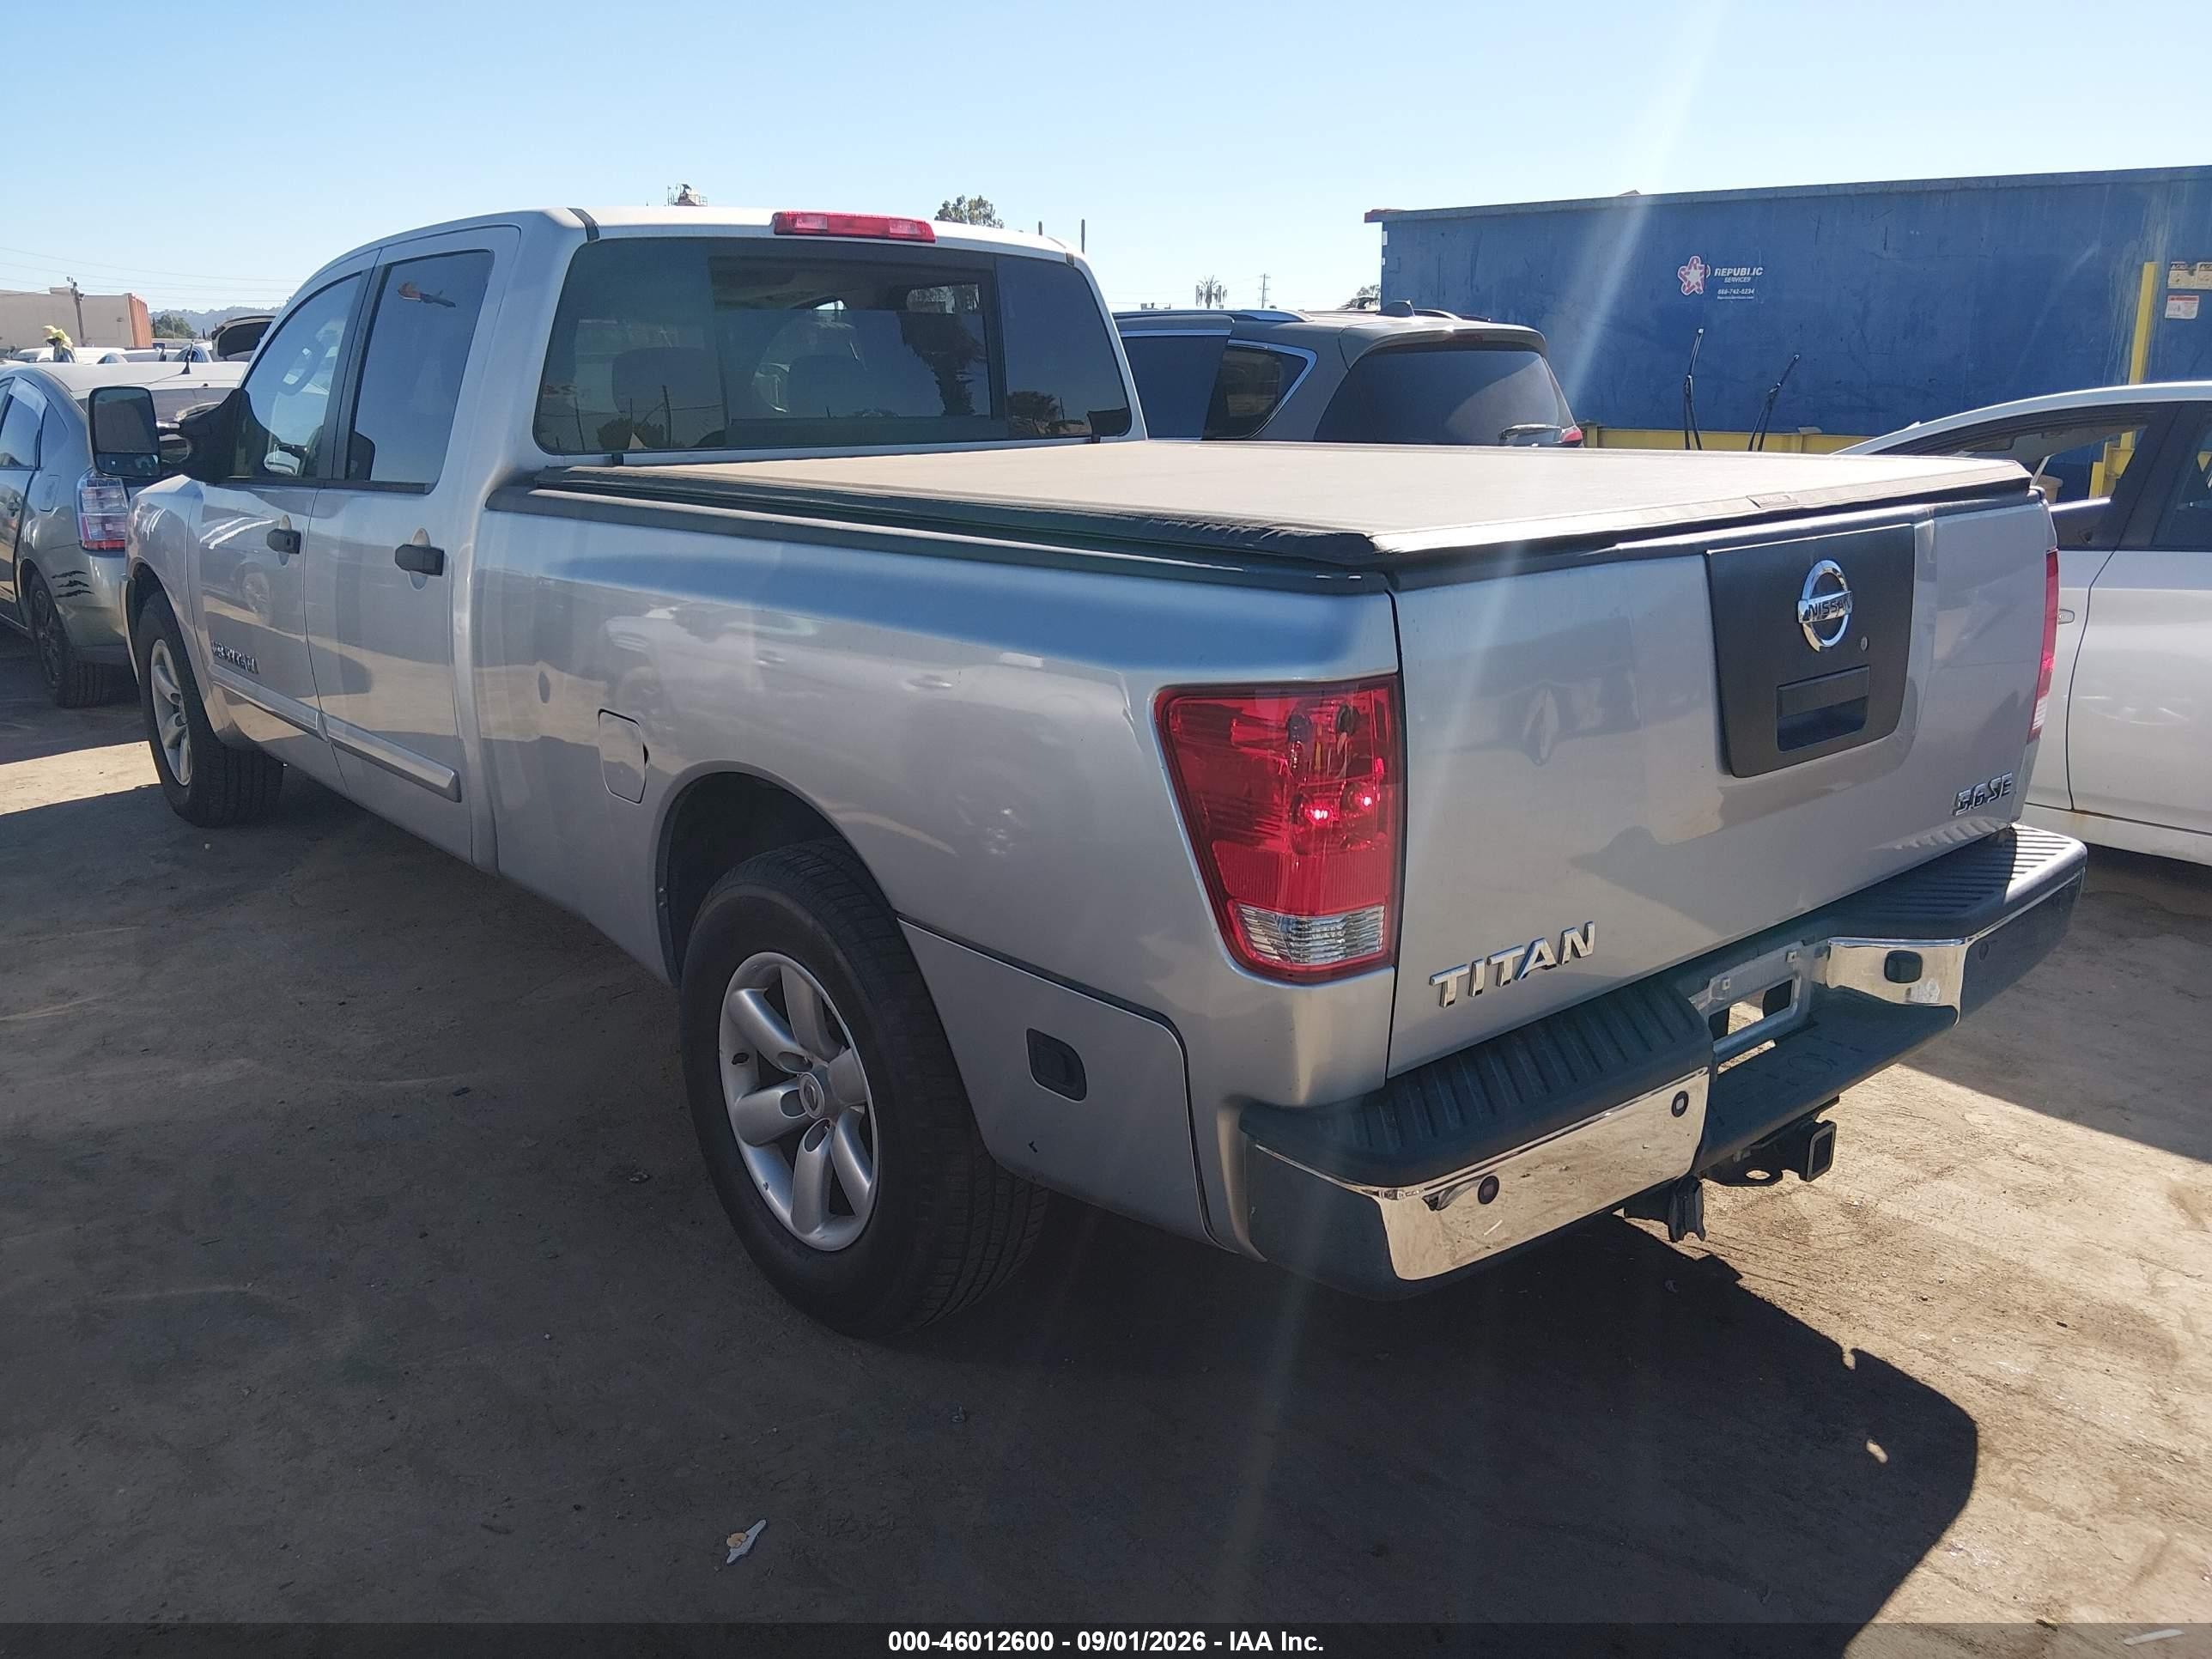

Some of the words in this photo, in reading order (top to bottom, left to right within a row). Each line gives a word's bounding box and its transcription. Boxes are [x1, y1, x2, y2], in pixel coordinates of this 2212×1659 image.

[1714, 267, 1764, 277] REPUBLIC
[1807, 594, 1852, 617] NISSAN
[1429, 921, 1595, 1008] TITAN
